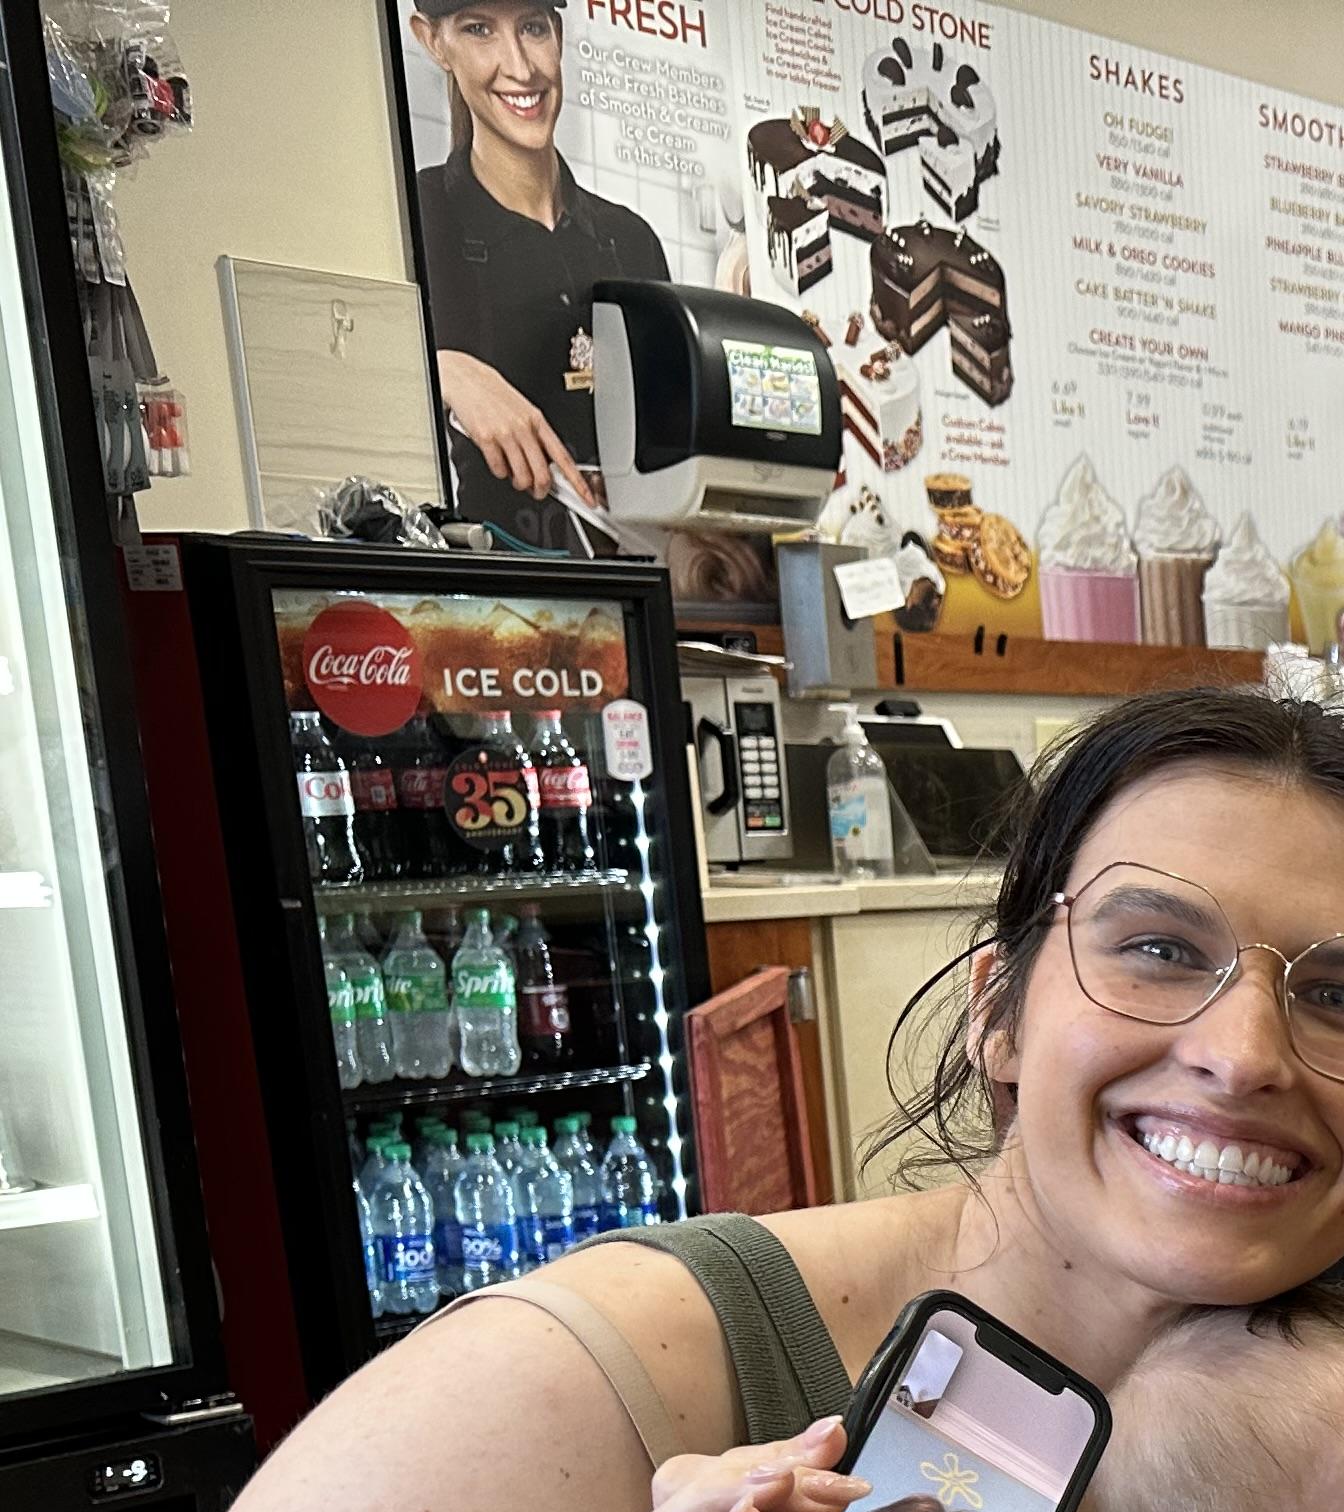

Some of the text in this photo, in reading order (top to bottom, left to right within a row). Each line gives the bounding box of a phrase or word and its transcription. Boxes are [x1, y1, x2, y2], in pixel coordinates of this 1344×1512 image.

[778, 18, 807, 36] Cream
[778, 31, 806, 48] Cream
[912, 4, 992, 50] STONE
[579, 40, 723, 90] Our Crew Members
[776, 55, 803, 72] Cream
[1089, 54, 1185, 104] SHAKES
[581, 69, 620, 88] make
[625, 75, 664, 99] Fresh
[668, 86, 726, 113] Batches
[580, 89, 731, 140] of Smooth & Creamy
[1103, 111, 1124, 130] OH
[621, 120, 696, 151] Ice Cream
[617, 144, 704, 176] in this Store
[1096, 152, 1185, 189] VERY VANILLA
[1263, 153, 1334, 184] STRAWBERRY
[1075, 191, 1208, 236] SAVORY STRAWBERRY
[1072, 236, 1216, 279] MILK & OREO COOKIES
[1074, 278, 1108, 300] CAKE
[1112, 286, 1159, 308] BATTER
[1178, 299, 1217, 321] SHAKE
[1270, 276, 1341, 302] STRAWBERRY
[1089, 327, 1209, 363] CREATE YOUR OWN
[1279, 319, 1321, 340] MANGO
[309, 645, 412, 686] Coca-Cola
[443, 667, 604, 697] ICE COLD
[452, 772, 527, 830] 35
